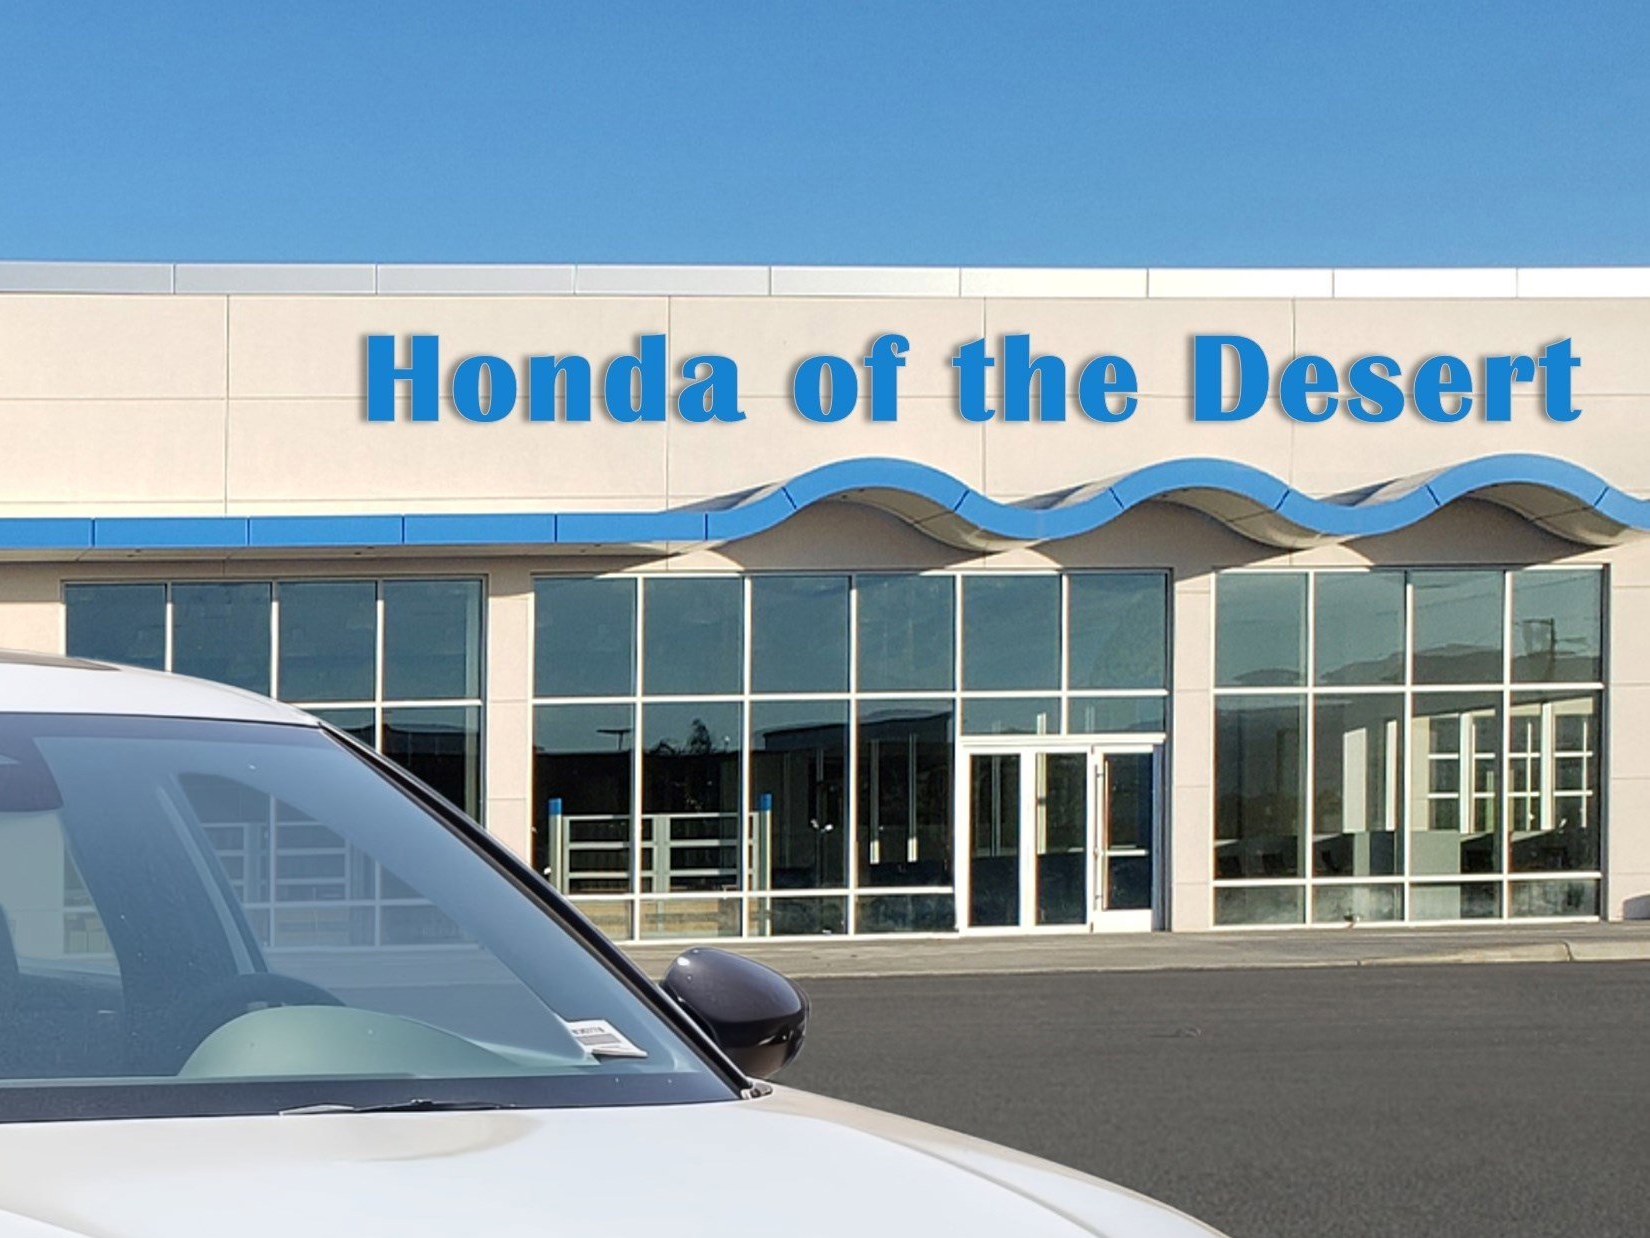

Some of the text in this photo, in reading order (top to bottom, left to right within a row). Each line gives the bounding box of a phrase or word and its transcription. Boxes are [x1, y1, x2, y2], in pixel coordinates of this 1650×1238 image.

[365, 332, 1582, 423] Honda of the Desert
